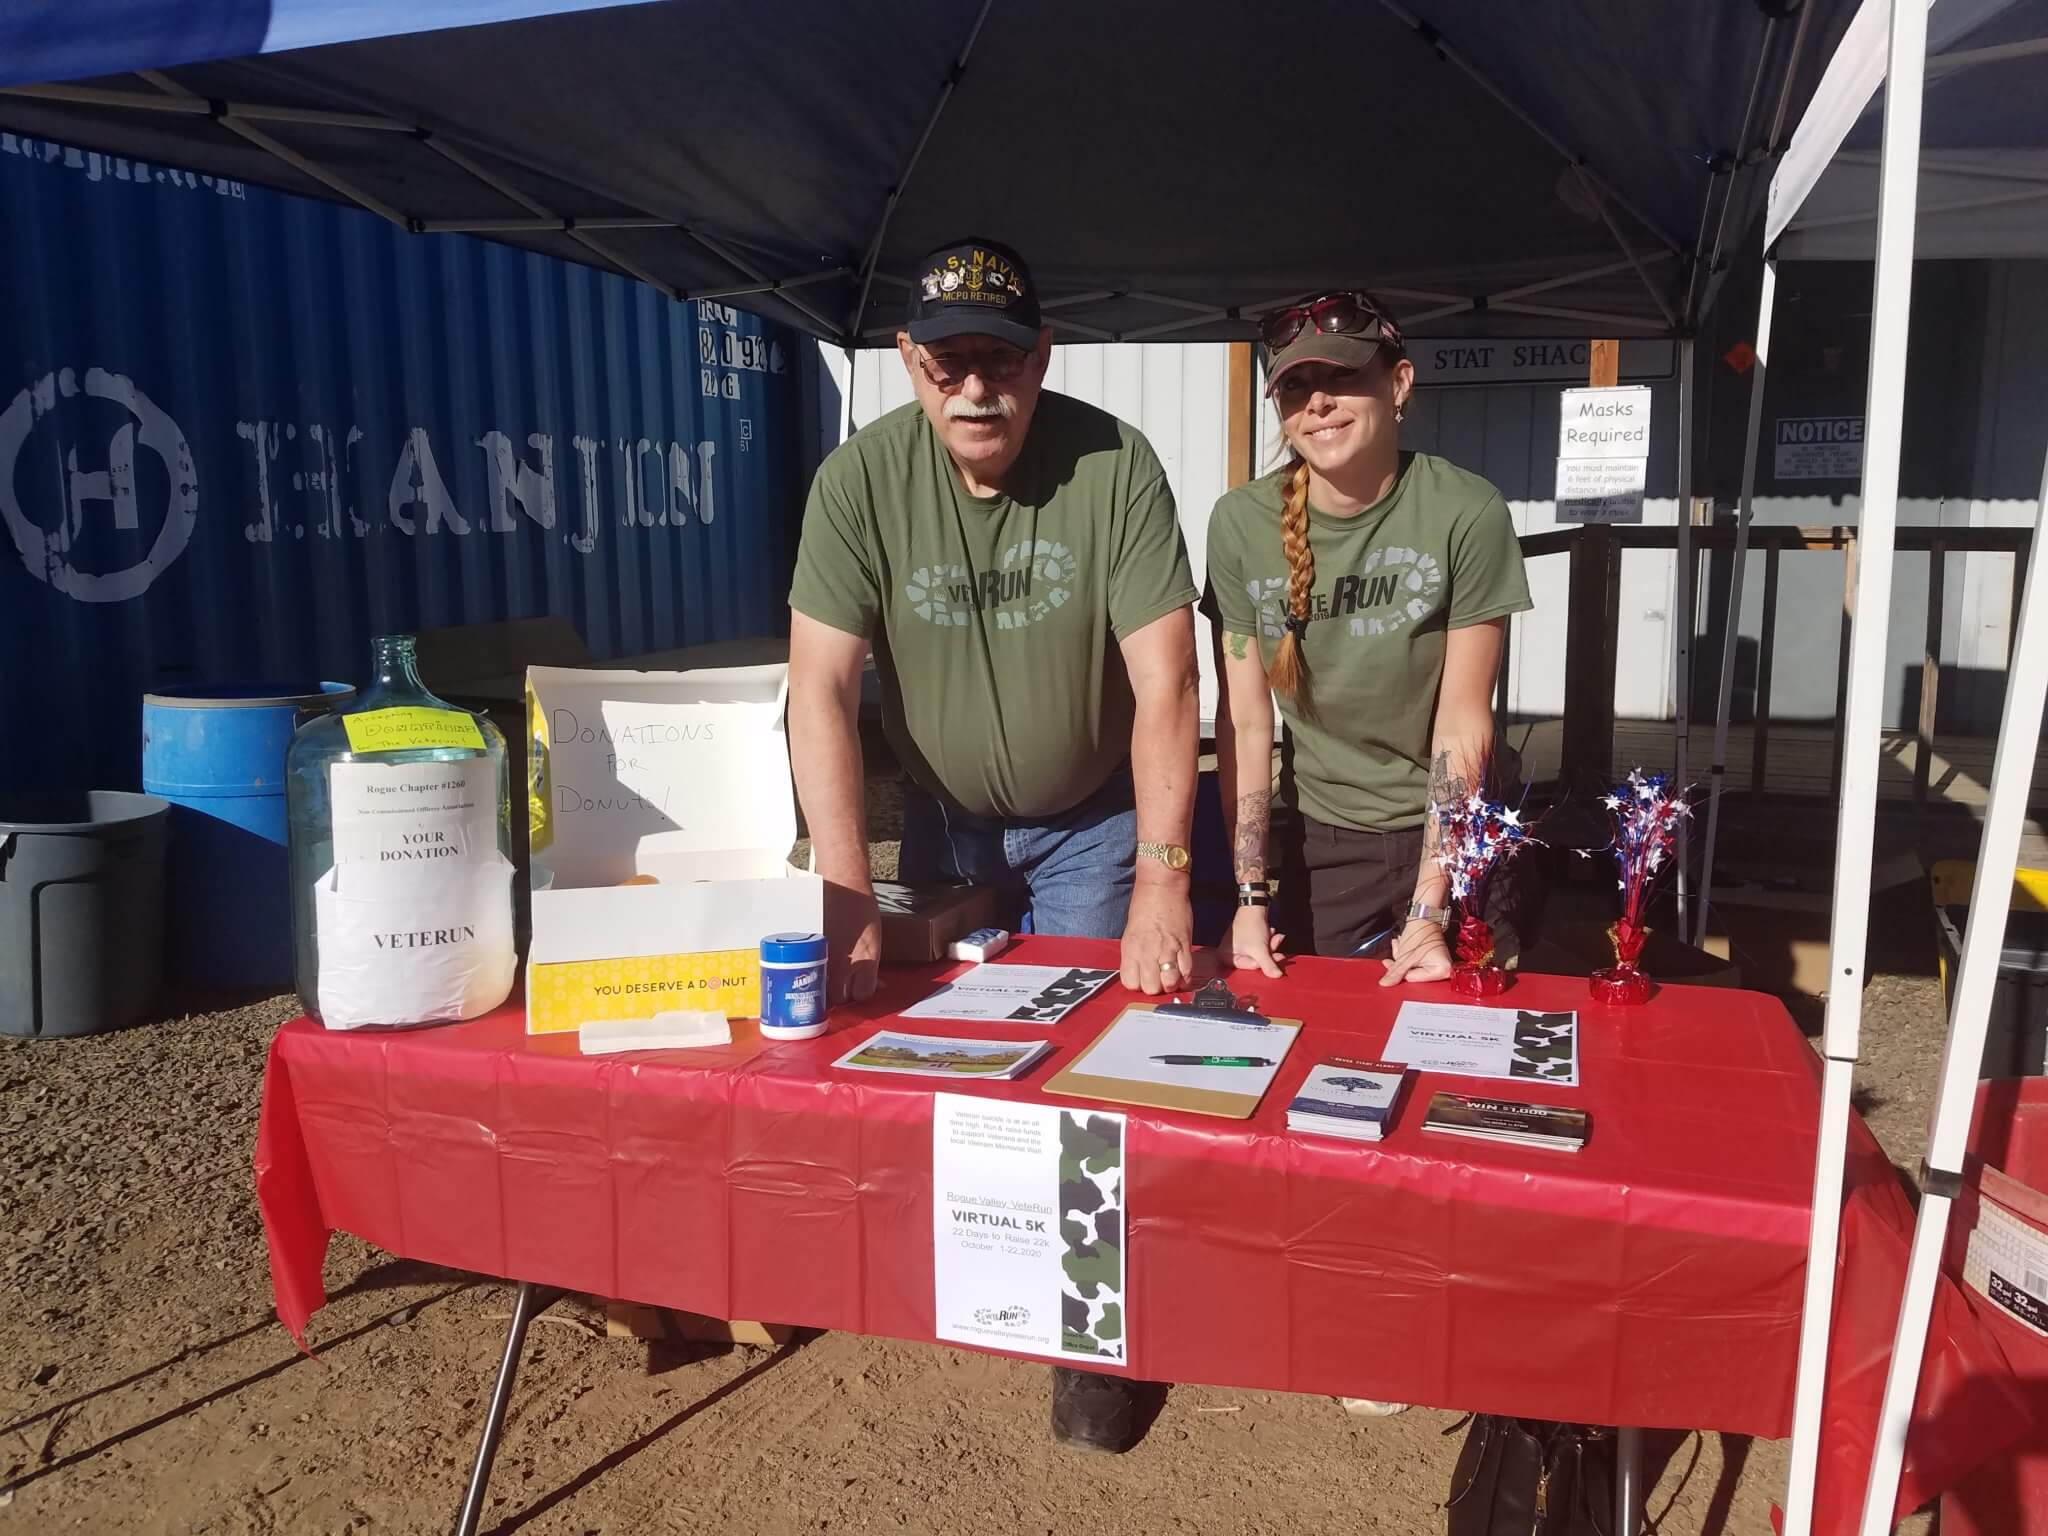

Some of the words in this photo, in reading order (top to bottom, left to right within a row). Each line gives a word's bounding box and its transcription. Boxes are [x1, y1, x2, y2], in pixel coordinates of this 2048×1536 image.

[974, 250, 1019, 283] NAVY
[942, 291, 968, 301] MCPO
[970, 292, 1007, 304] RETIRED
[1434, 348, 1495, 369] STAT
[1513, 343, 1587, 367] SHAC
[1579, 401, 1634, 417] Masks
[1567, 426, 1644, 447] Required
[1781, 420, 1863, 442] NOTICE
[1583, 463, 1602, 472] must
[1606, 462, 1639, 472] maintain
[606, 753, 649, 772] FOR
[367, 785, 397, 794] Rogue
[400, 782, 439, 793] Chapter
[441, 780, 466, 790] #1260
[402, 831, 446, 845] YOUR
[380, 846, 459, 862] DONATION
[373, 925, 476, 949] VETERUN
[594, 984, 622, 996] YOU
[625, 981, 683, 994] DESERVE
[688, 982, 695, 990] A
[700, 976, 748, 990] DONUT
[1410, 1030, 1476, 1040] VIRTUAL
[1466, 1101, 1498, 1111] WIN
[960, 1130, 985, 1139] support
[1016, 1137, 1029, 1145] and
[1023, 1128, 1042, 1137] funds
[946, 1191, 977, 1204] Rogue
[952, 1209, 1022, 1230] VIRTUAL
[1025, 1219, 1047, 1234] 5K
[952, 1226, 965, 1236] 22
[966, 1229, 989, 1241] Days
[991, 1231, 1001, 1241] to
[1004, 1232, 1031, 1245] Raise
[960, 1239, 993, 1251] October
